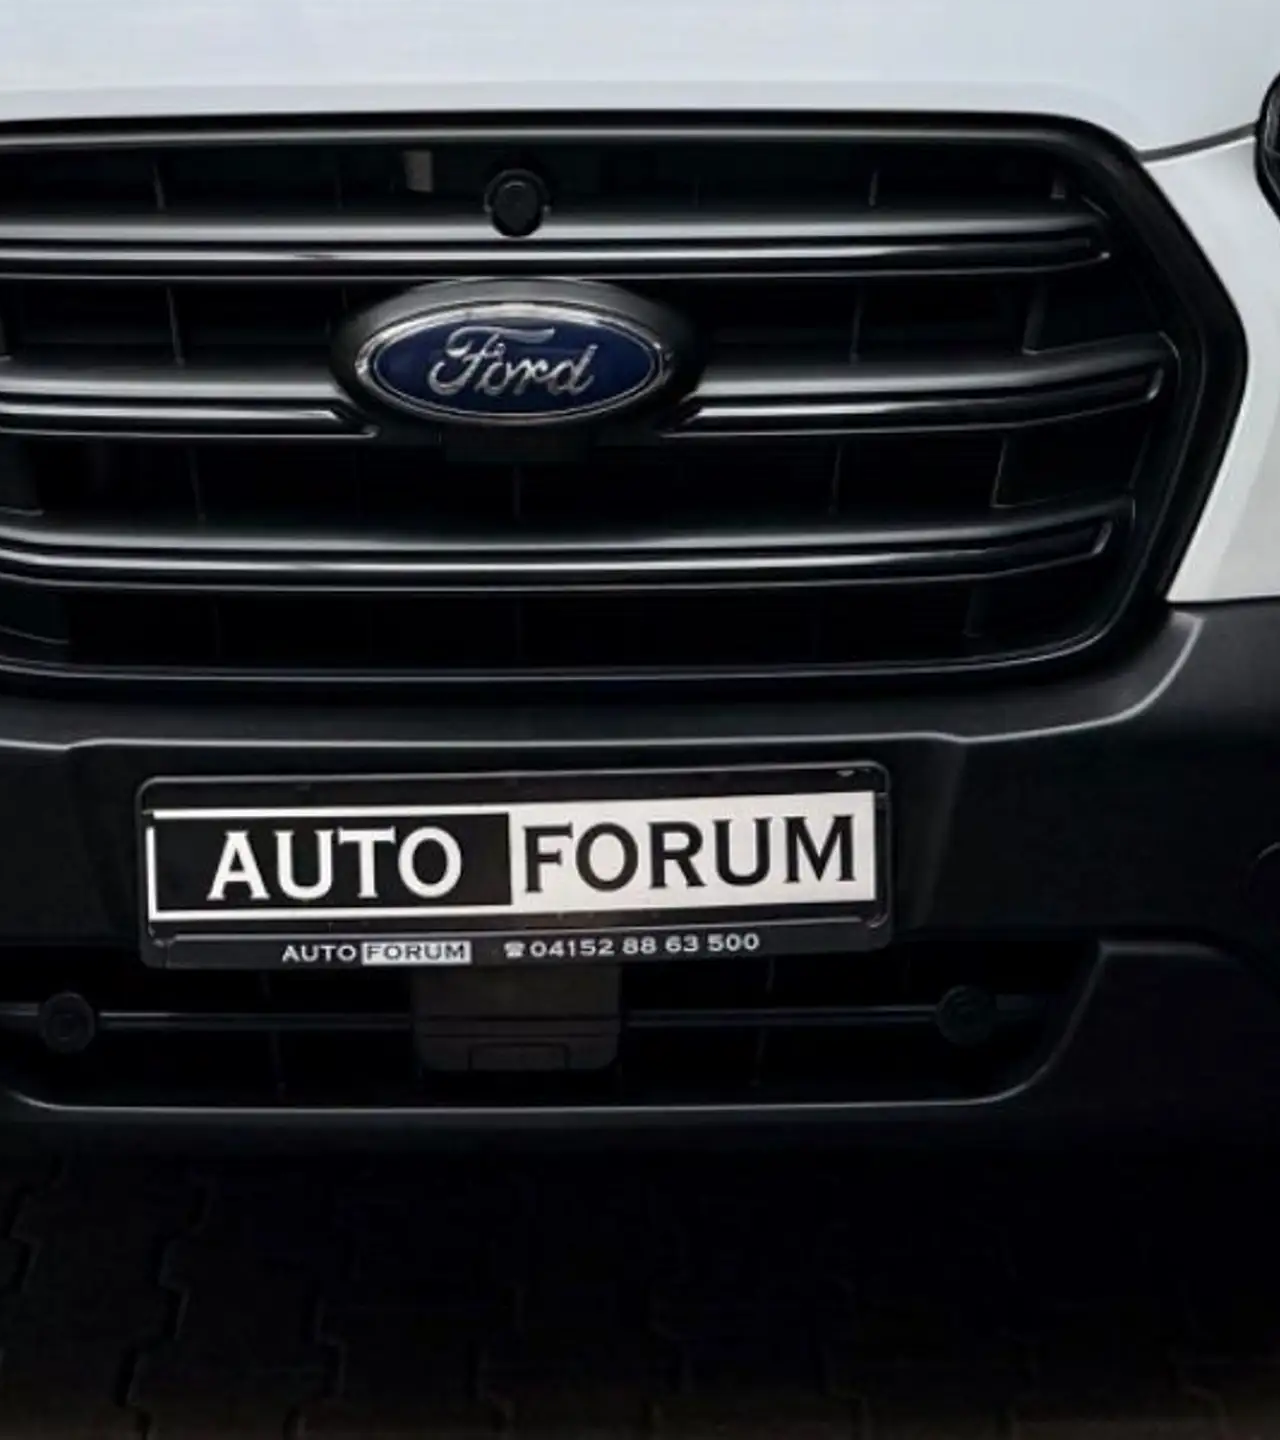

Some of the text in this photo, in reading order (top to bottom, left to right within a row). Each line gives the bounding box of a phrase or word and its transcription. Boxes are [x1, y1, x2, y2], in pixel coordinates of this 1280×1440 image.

[427, 325, 599, 396] Ford
[206, 813, 857, 902] AUTO FORUM
[282, 932, 760, 963] AUTO FORUM 04152 88 63 500
